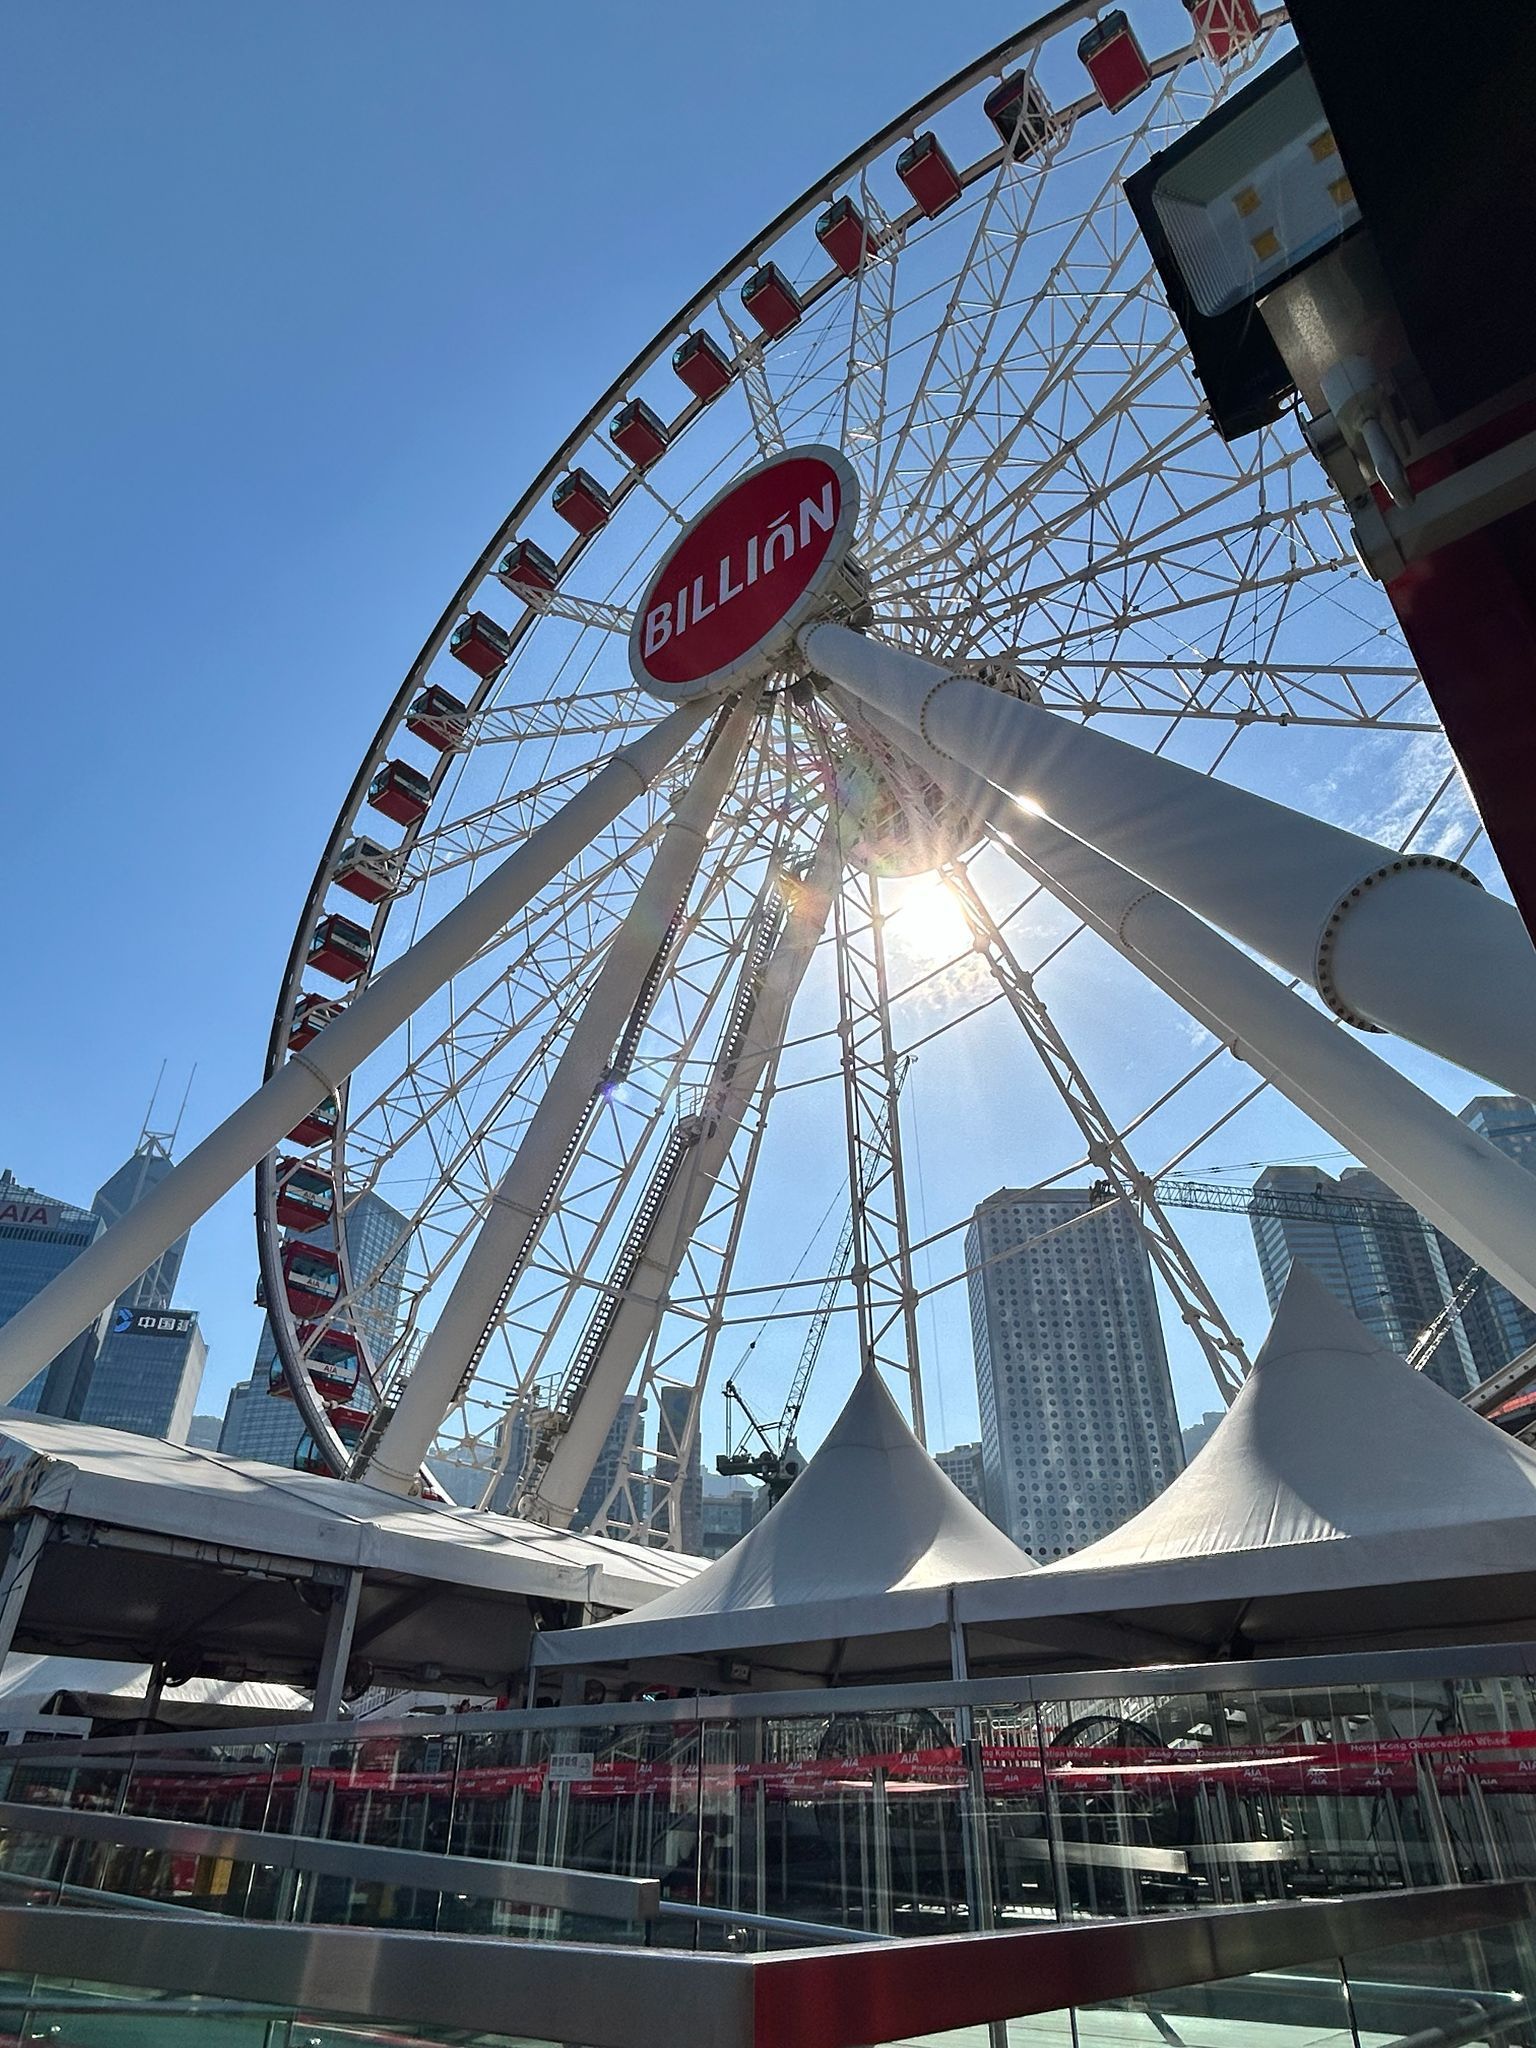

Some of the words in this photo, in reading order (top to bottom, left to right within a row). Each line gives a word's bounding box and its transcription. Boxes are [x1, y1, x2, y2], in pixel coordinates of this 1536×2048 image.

[0, 1204, 48, 1225] AIA
[900, 1753, 919, 1763] AIA
[785, 1762, 803, 1770] AIA
[841, 1759, 859, 1768] AIA
[1244, 1768, 1262, 1777] AIA
[1373, 1767, 1394, 1775] AIA
[1444, 1765, 1465, 1774] AIA
[1004, 1774, 1019, 1782] AIA
